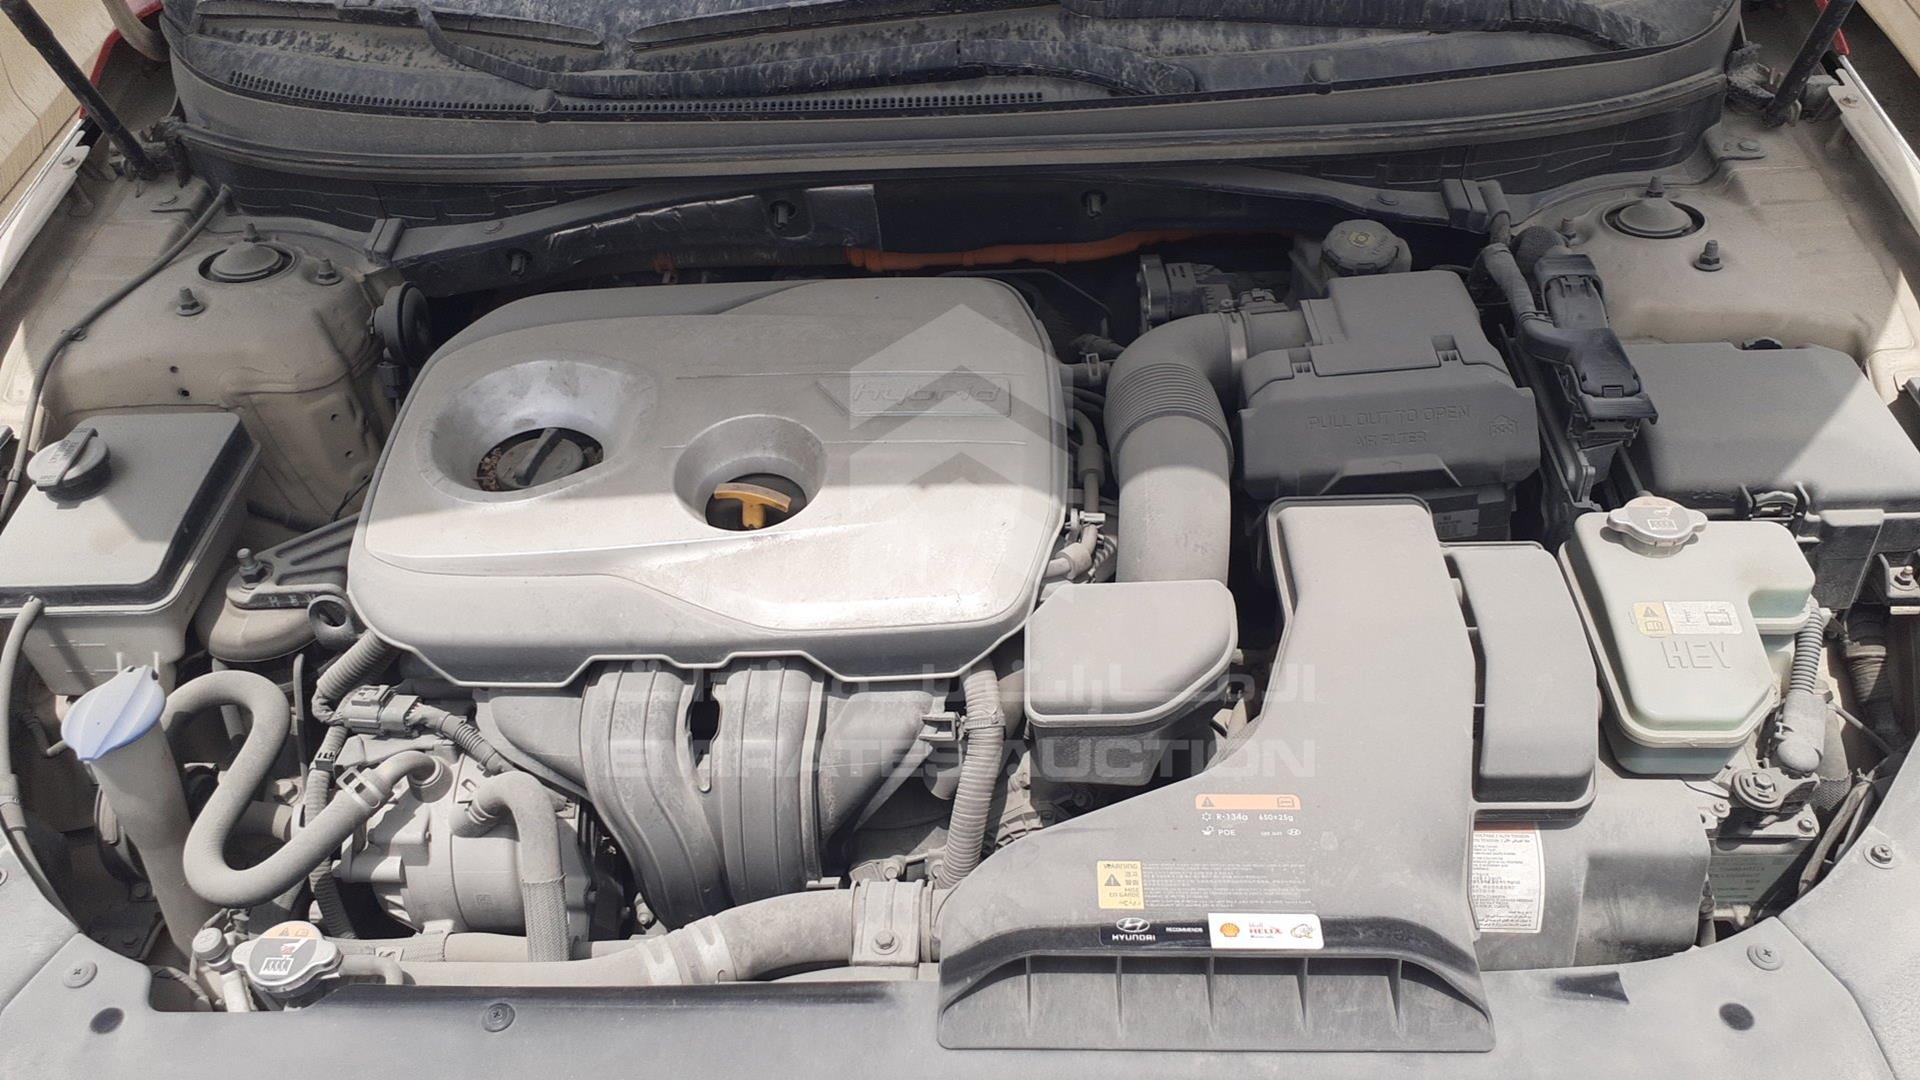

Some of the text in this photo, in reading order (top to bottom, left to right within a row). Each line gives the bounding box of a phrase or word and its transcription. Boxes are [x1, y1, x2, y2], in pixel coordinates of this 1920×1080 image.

[1306, 404, 1472, 430] PULL OUT TO OPEN
[1354, 430, 1428, 449] AIR FILTER
[1660, 640, 1733, 670] HEV
[1217, 828, 1237, 837] POE
[1111, 933, 1156, 942] HYUNDAI
